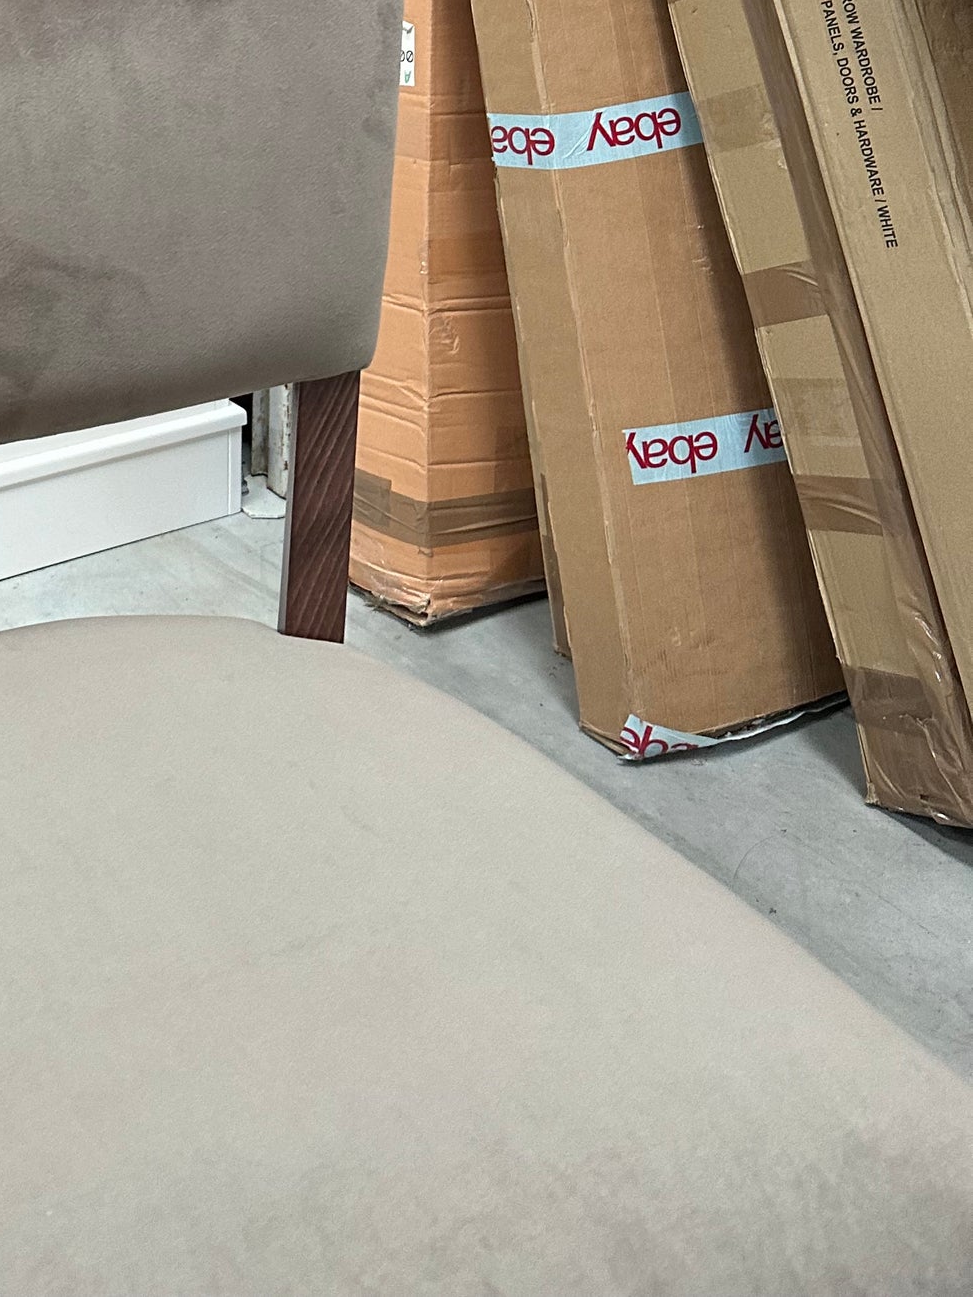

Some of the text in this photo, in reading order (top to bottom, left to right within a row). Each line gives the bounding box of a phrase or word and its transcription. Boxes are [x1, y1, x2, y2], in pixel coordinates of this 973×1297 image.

[821, 0, 845, 56] PANELS,
[837, 57, 859, 105] DOORS
[850, 26, 881, 105] WARDROBE
[586, 107, 681, 151] ebay
[850, 107, 862, 117] &
[854, 119, 884, 196] HARDWARE
[877, 205, 898, 248] WHITE
[625, 431, 718, 474] ebay
